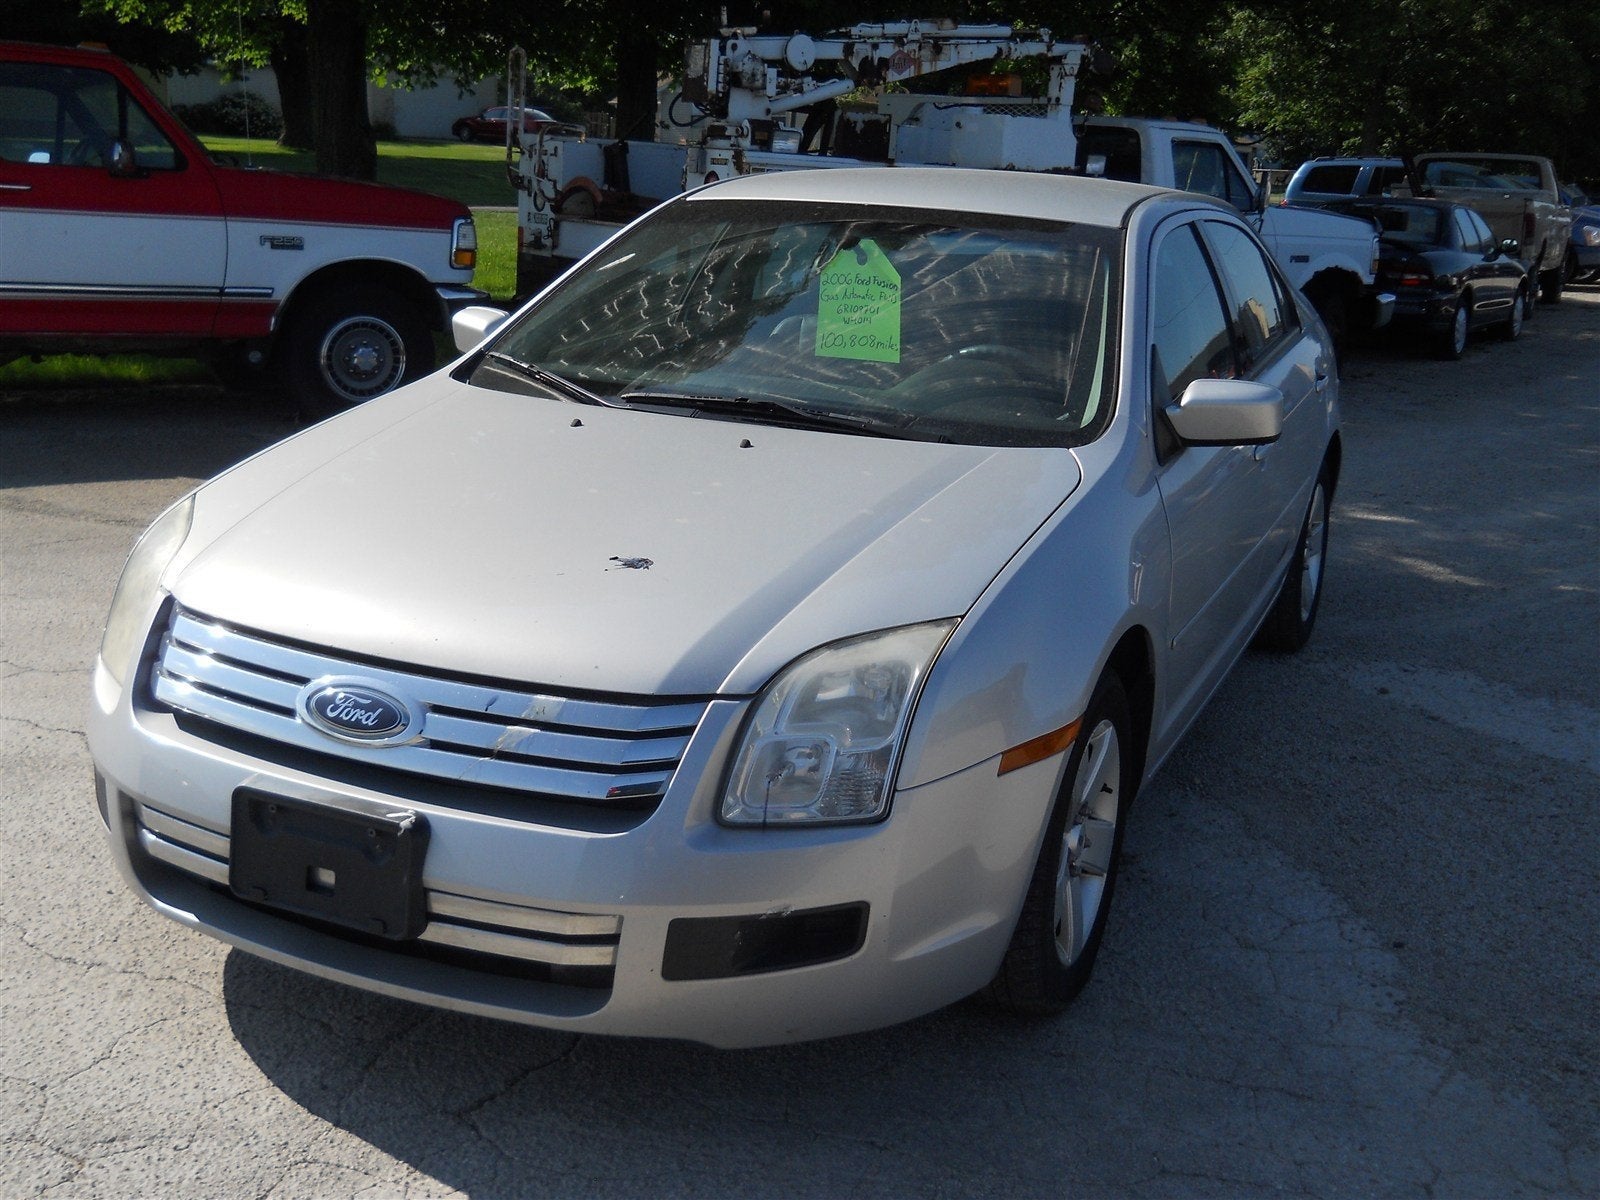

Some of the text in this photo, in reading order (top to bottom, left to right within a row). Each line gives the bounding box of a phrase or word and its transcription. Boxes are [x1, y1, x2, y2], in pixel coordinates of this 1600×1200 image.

[821, 273, 899, 292] 2006 Ford Fusion
[820, 289, 839, 302] Gas
[327, 692, 383, 726] Ford
